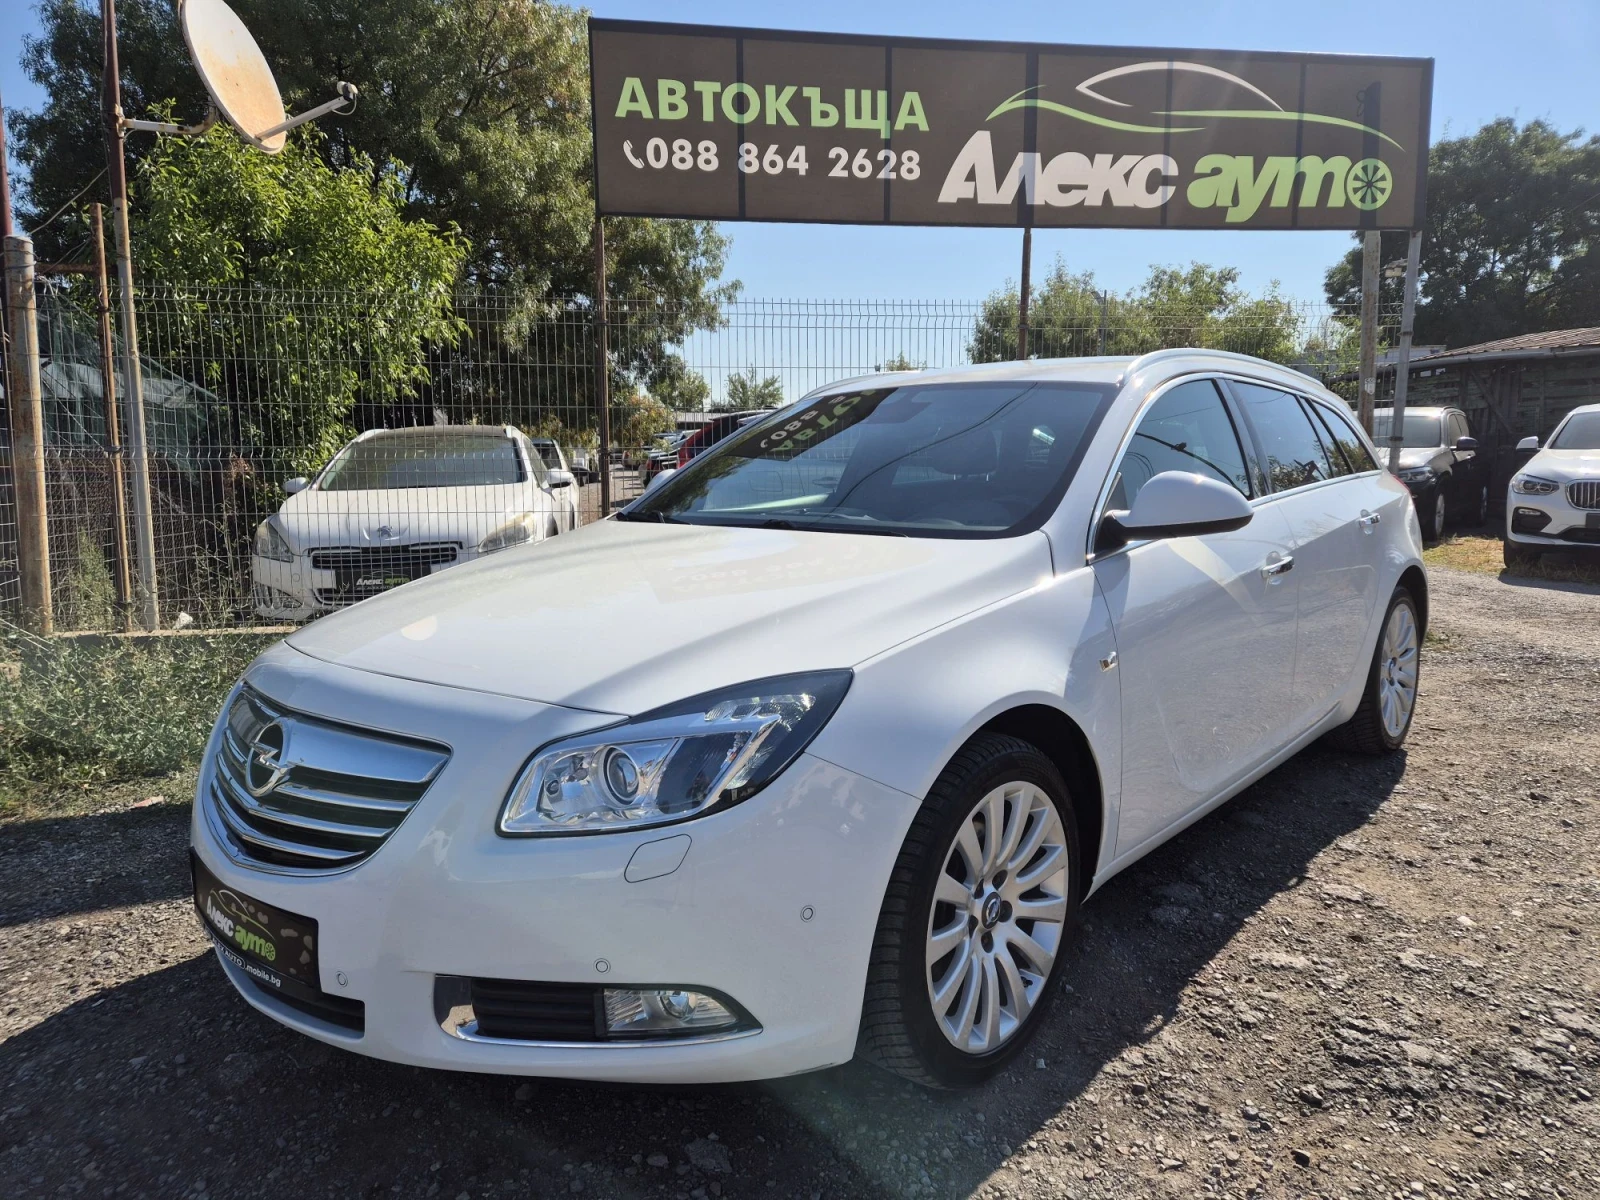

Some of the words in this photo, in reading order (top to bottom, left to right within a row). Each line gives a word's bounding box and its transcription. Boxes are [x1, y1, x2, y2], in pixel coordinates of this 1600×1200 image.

[615, 76, 930, 139] АВТОКЪЩА
[645, 137, 719, 172] 088
[737, 142, 809, 176] 864
[827, 146, 921, 181] 2628
[937, 130, 1179, 209] Алекс
